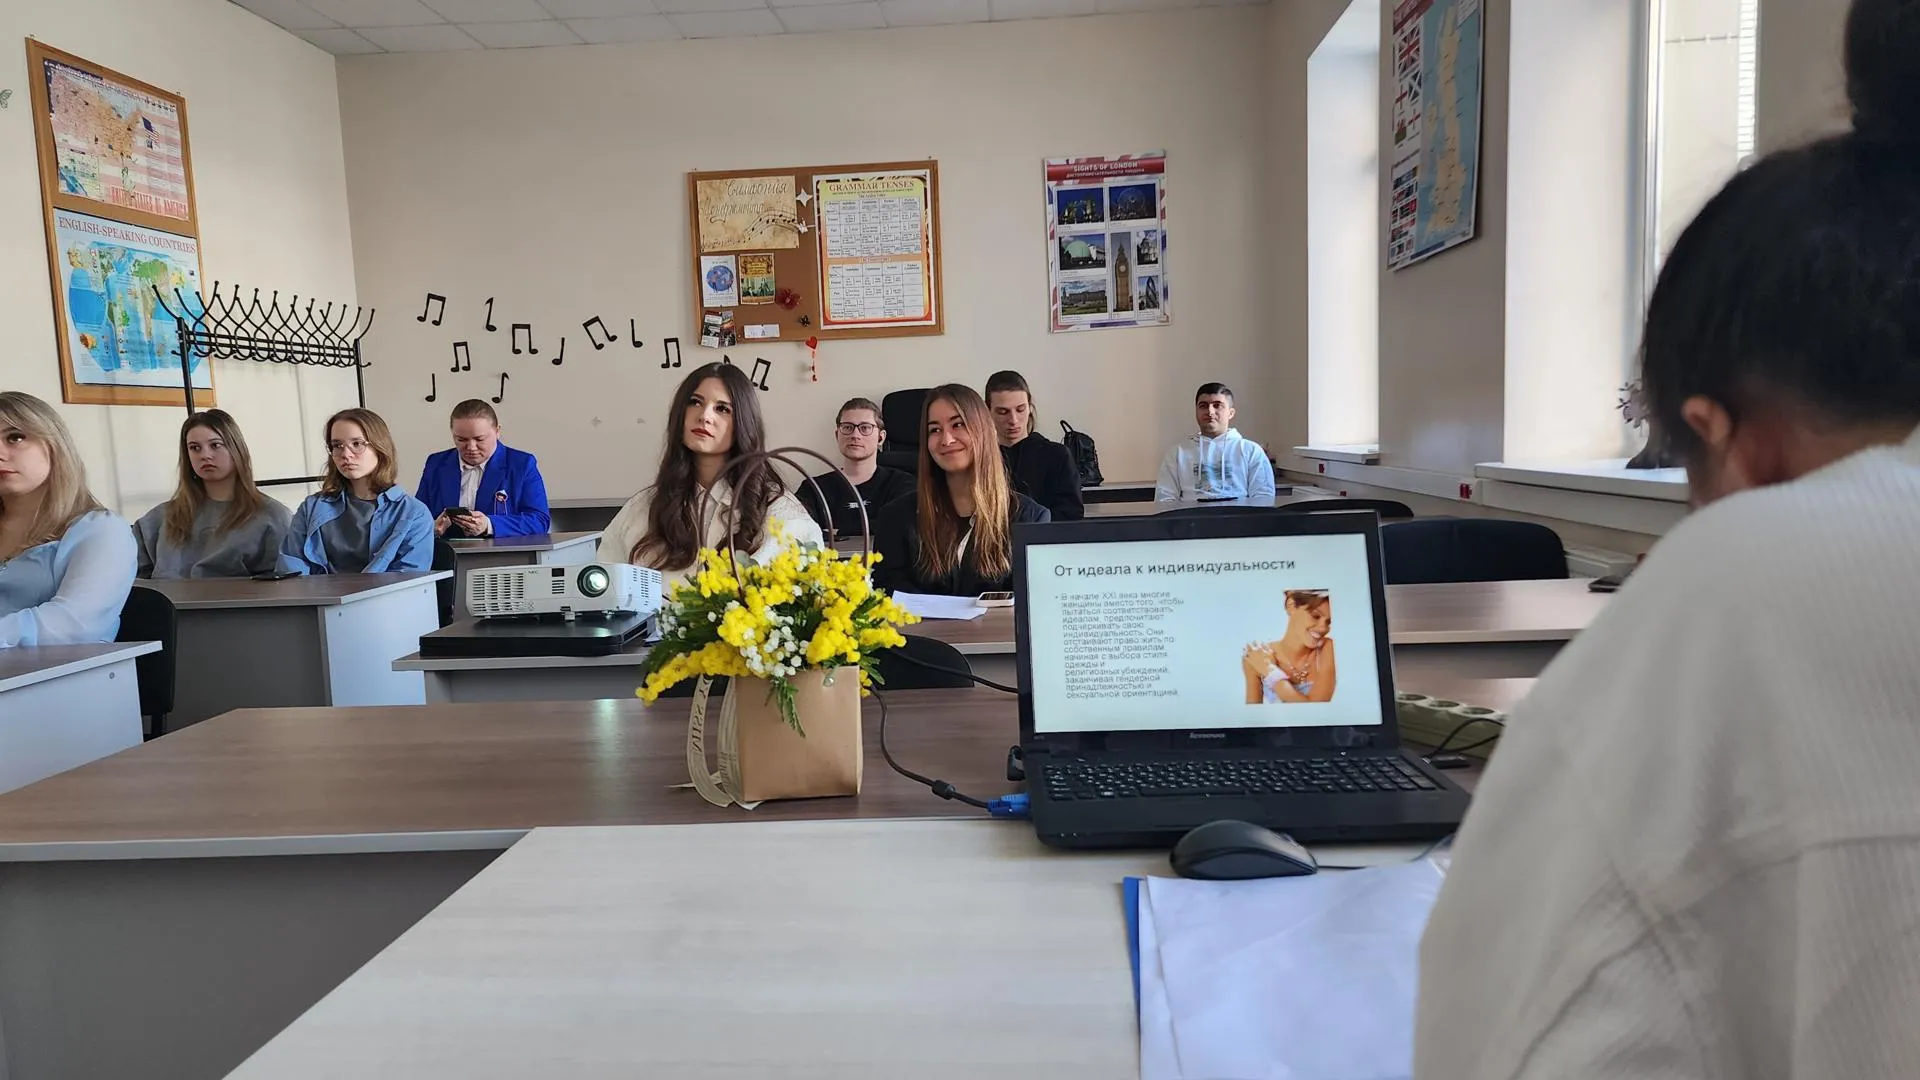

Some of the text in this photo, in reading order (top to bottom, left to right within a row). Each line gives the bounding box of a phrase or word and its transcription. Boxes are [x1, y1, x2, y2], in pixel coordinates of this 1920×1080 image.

[1073, 164, 1098, 172] SIGHTS
[1110, 162, 1138, 170] LONDON
[829, 181, 879, 192] GRAMMAR
[881, 180, 914, 189] TENSES
[59, 217, 196, 254] ENGLISH-SPEAKING COUNTRIES
[1054, 560, 1296, 578] От идеала к индивидуальности
[1140, 591, 1171, 599] многие
[1159, 597, 1184, 605] чтобы
[1146, 628, 1164, 636] Они
[1064, 638, 1112, 646] отстаивают
[1064, 645, 1120, 653] собственным
[1108, 652, 1141, 660] выбора
[1065, 661, 1099, 669] одежды
[1065, 668, 1120, 676] религиозных
[1116, 674, 1160, 682] гендерной
[1066, 683, 1145, 691] принадлежностью
[1066, 691, 1120, 699] сексуальной
